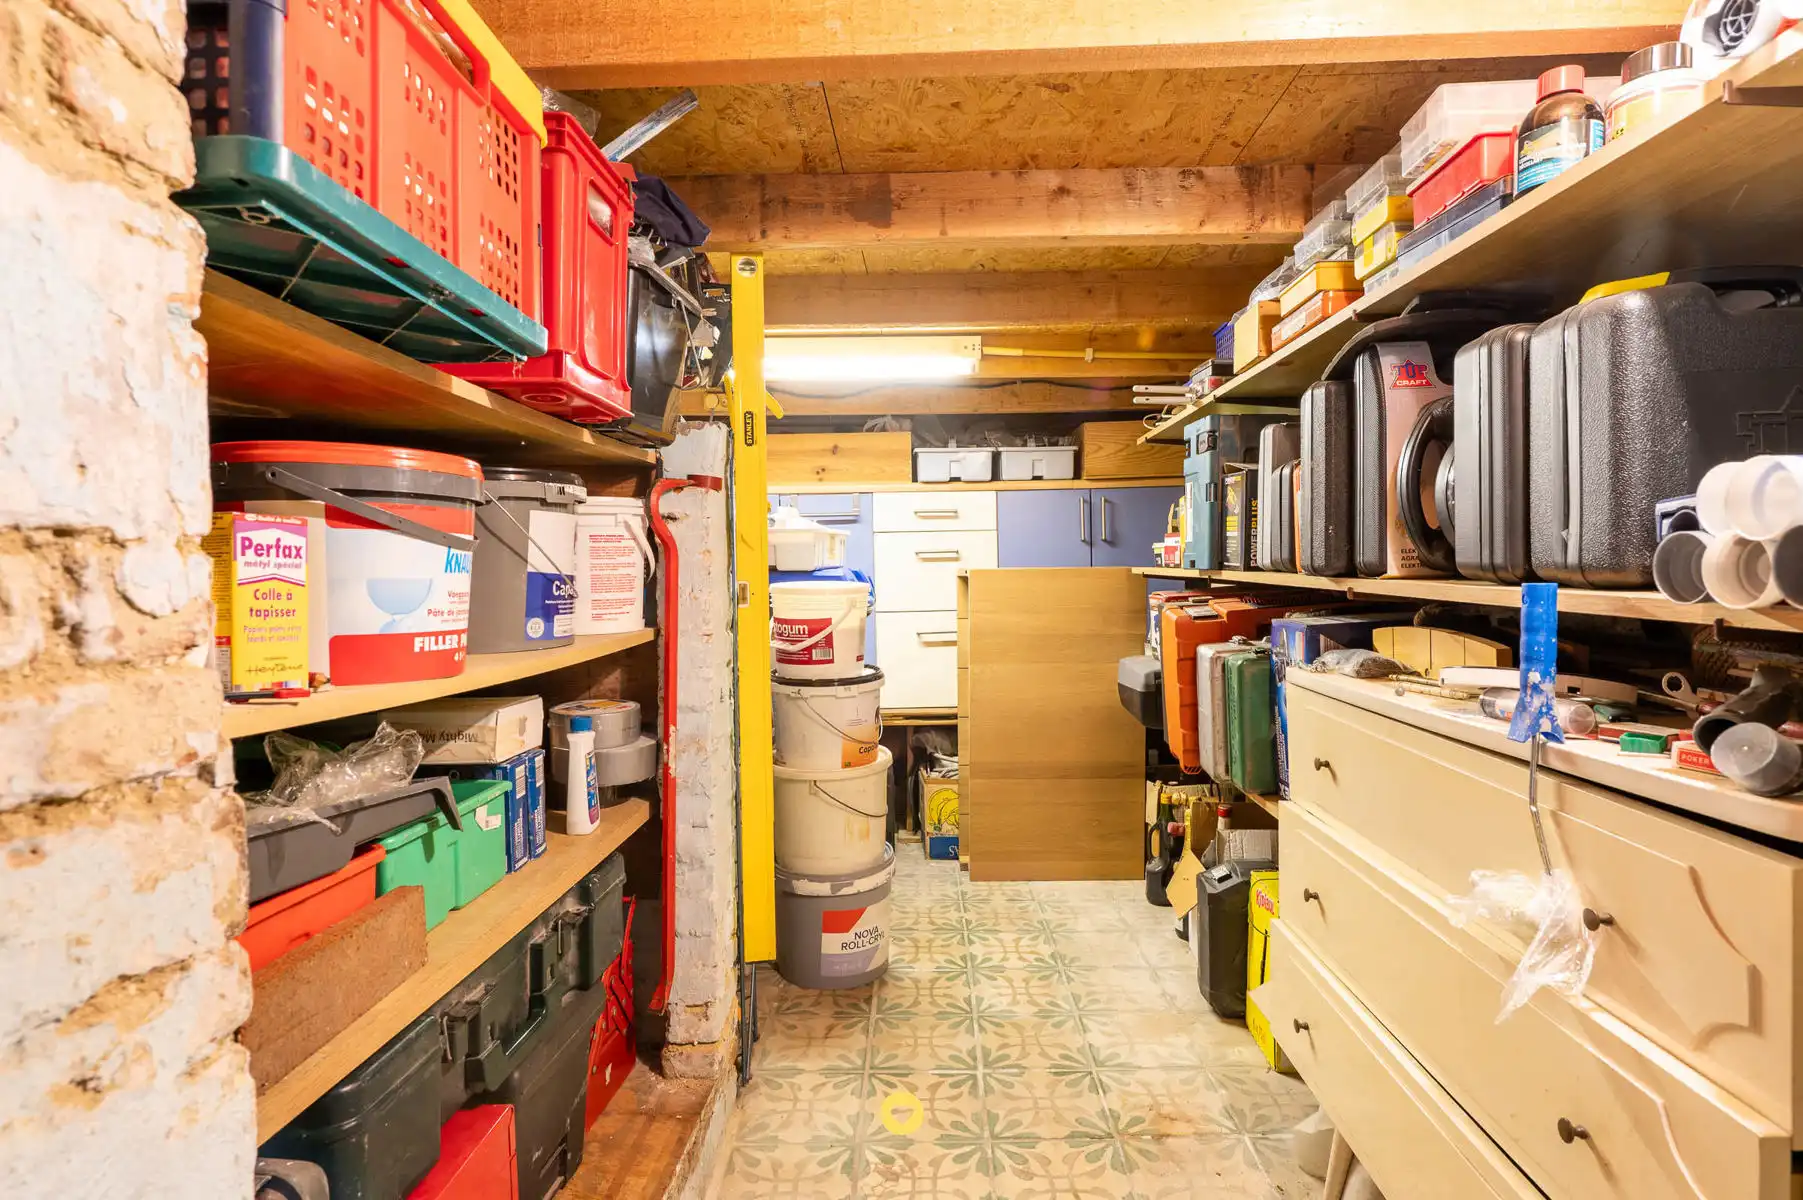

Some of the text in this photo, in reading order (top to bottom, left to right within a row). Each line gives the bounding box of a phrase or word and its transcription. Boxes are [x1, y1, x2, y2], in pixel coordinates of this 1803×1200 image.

[1396, 379, 1427, 387] CRAFT
[745, 412, 753, 445] STANLEY
[1250, 499, 1258, 567] POWERPLUS
[240, 535, 303, 560] Perfax
[254, 588, 282, 601] Colle
[248, 604, 297, 620] tapisser
[413, 634, 459, 652] FILLER
[438, 729, 479, 744] Mighty
[1681, 752, 1710, 766] POKER
[854, 925, 880, 940] NOVA
